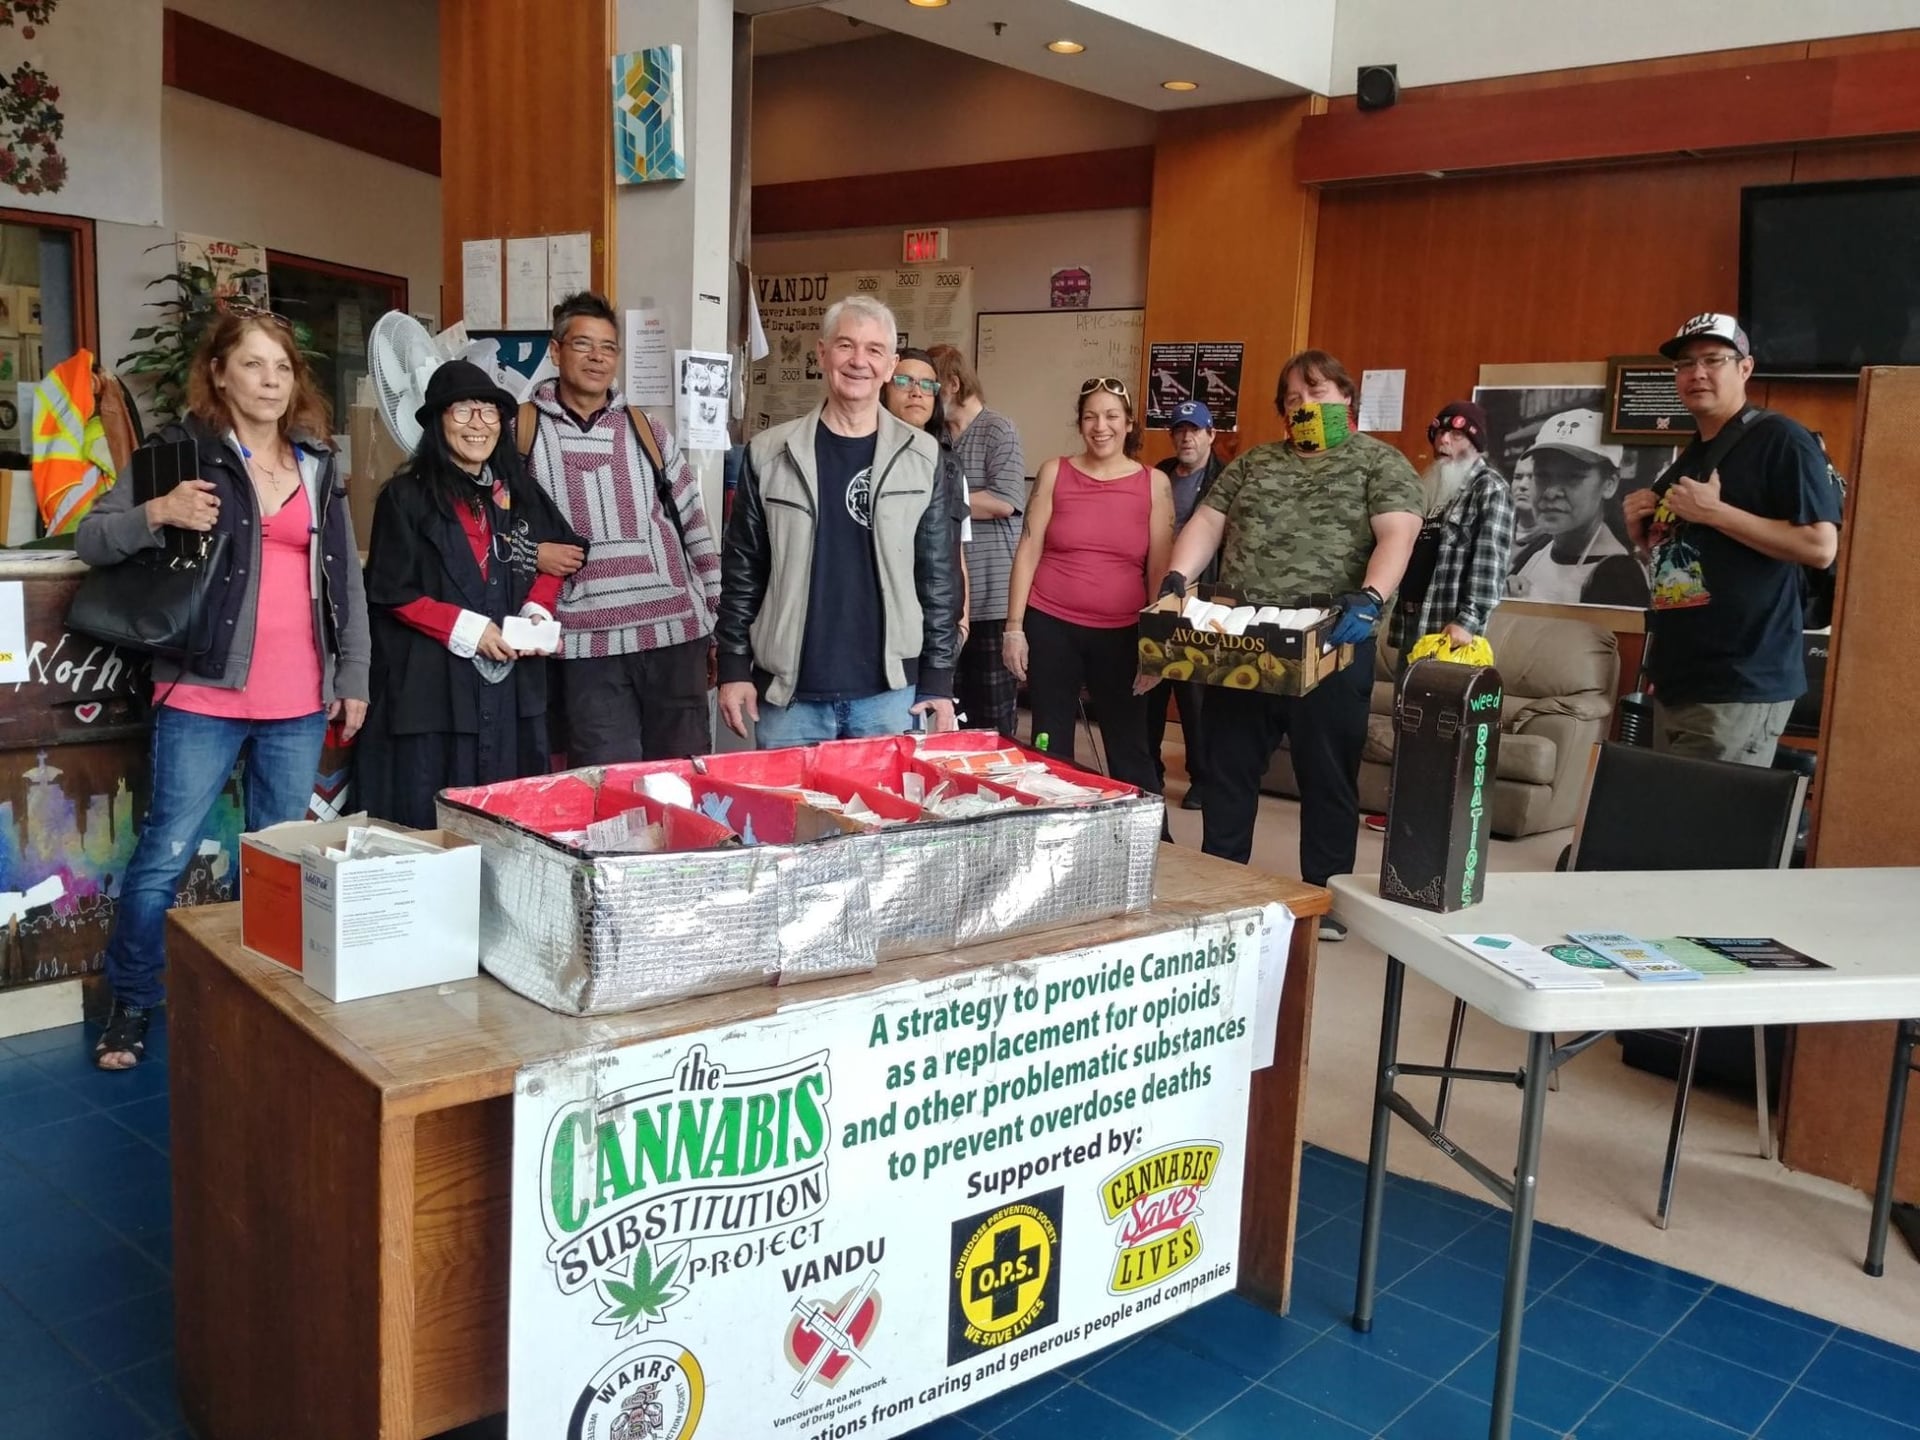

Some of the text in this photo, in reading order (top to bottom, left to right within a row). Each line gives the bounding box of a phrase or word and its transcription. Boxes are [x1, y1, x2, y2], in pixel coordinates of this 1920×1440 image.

[208, 243, 239, 257] SNAP
[906, 231, 938, 261] EXIT
[758, 276, 829, 303] VANDU
[898, 273, 920, 285] 2007
[936, 273, 960, 286] 2008
[771, 320, 794, 333] Drug
[795, 320, 820, 331] Users
[785, 306, 807, 317] Area
[15, 633, 136, 694] Noth
[1171, 627, 1265, 652] AVOCADOS
[1470, 686, 1502, 711] weed
[1461, 723, 1489, 909] DONATIONS
[868, 935, 1237, 1048] A strategy to provide Cannabis
[886, 979, 1221, 1090] as a replacement for opioids
[679, 1052, 721, 1092] the
[842, 1016, 1246, 1149] and other problematic substances
[888, 1061, 1211, 1181] to prevent overdose deaths
[550, 1072, 824, 1233] CANNABIS
[967, 1126, 1143, 1199] Supported by:
[1111, 1150, 1213, 1210] CANNABIS
[560, 1172, 821, 1286] SUBSTITUTION
[1121, 1178, 1202, 1243] Saves
[781, 1237, 885, 1293] VANDU
[954, 1204, 1058, 1279] OVERDOSE PREVENTION SOCIETY
[1120, 1228, 1194, 1285] LIVES
[979, 1254, 1034, 1292] O.P.S.
[872, 1396, 914, 1425] from
[918, 1371, 972, 1404] caring
[975, 1353, 1006, 1382] and
[1009, 1327, 1081, 1372] generous
[1084, 1303, 1132, 1340] people
[1135, 1288, 1161, 1313] and
[1164, 1261, 1231, 1301] companies
[963, 1298, 1046, 1347] WE SAVE LIVES
[596, 1360, 675, 1404] WAHRS
[674, 1382, 686, 1414] SOCIETY
[773, 1376, 888, 1429] Vancouver Area Network
[586, 1412, 598, 1440] WESTE
[800, 1399, 862, 1429] of Drug Users
